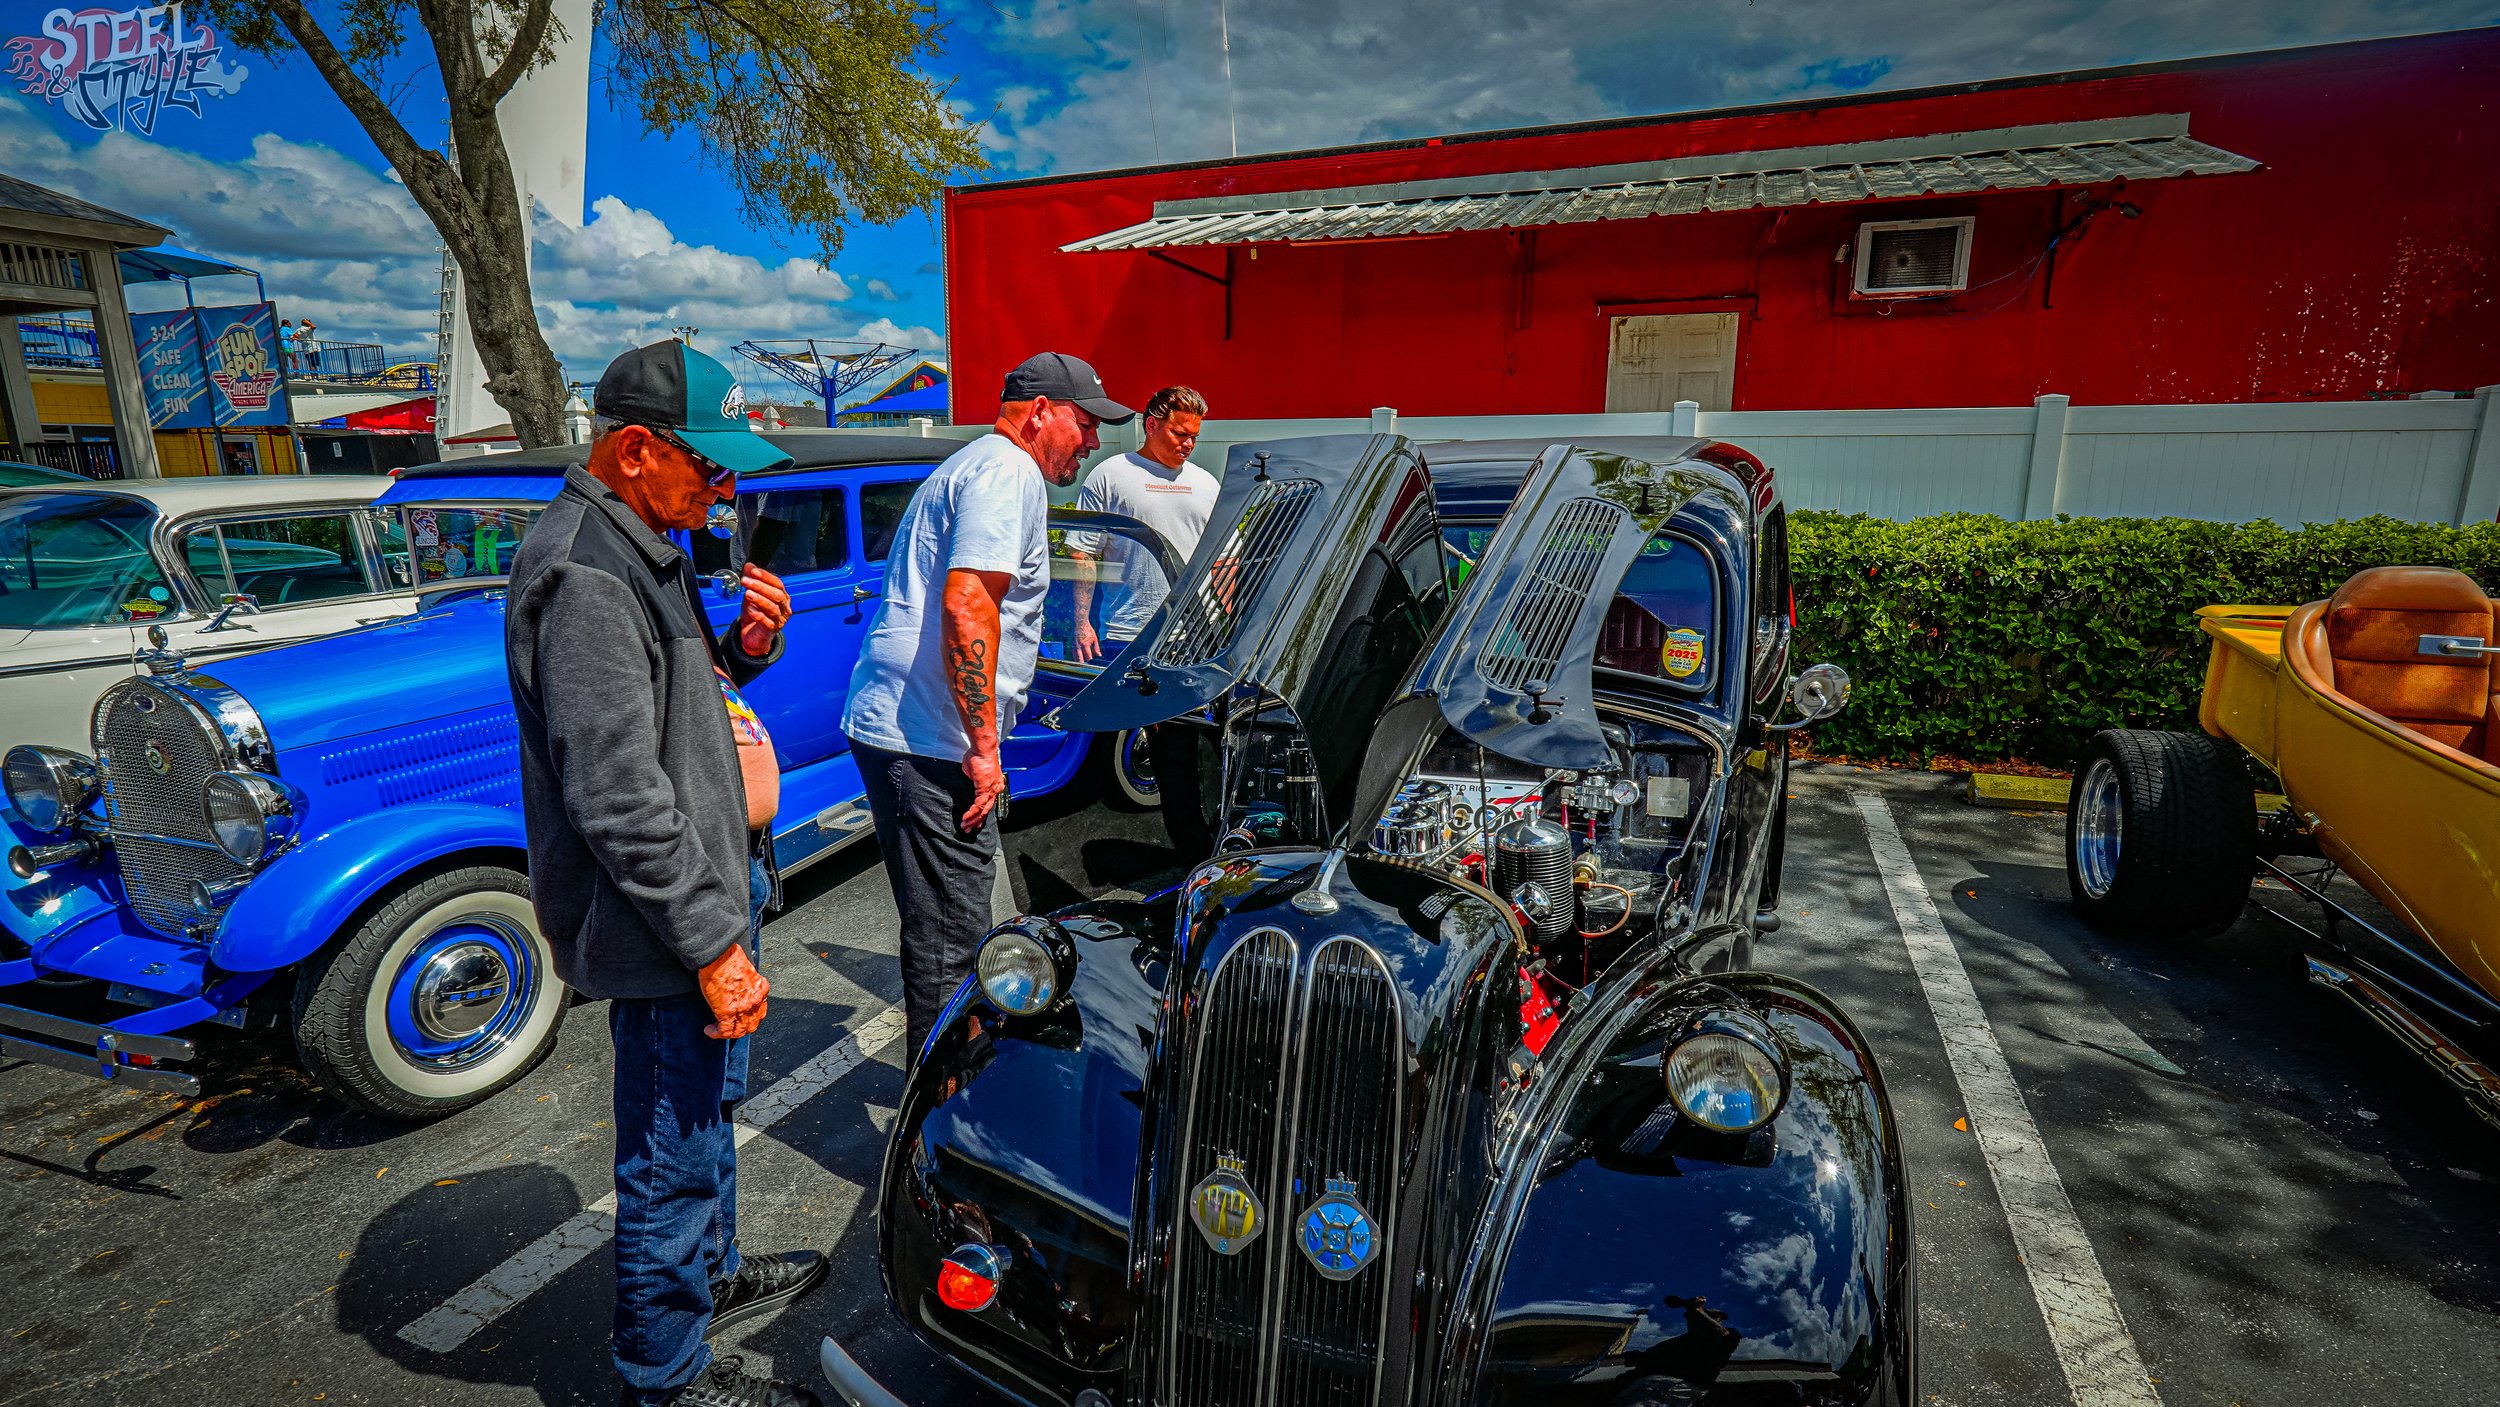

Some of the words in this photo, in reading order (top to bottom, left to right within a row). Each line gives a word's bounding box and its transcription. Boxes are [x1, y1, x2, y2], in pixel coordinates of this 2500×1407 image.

[221, 331, 256, 361] FUN
[152, 349, 182, 366] SAFE
[225, 350, 266, 381] SPOT
[152, 373, 191, 390] CLEAN
[229, 379, 266, 396] AMERICA
[163, 397, 190, 413] FUN
[1667, 649, 1698, 660] 2025
